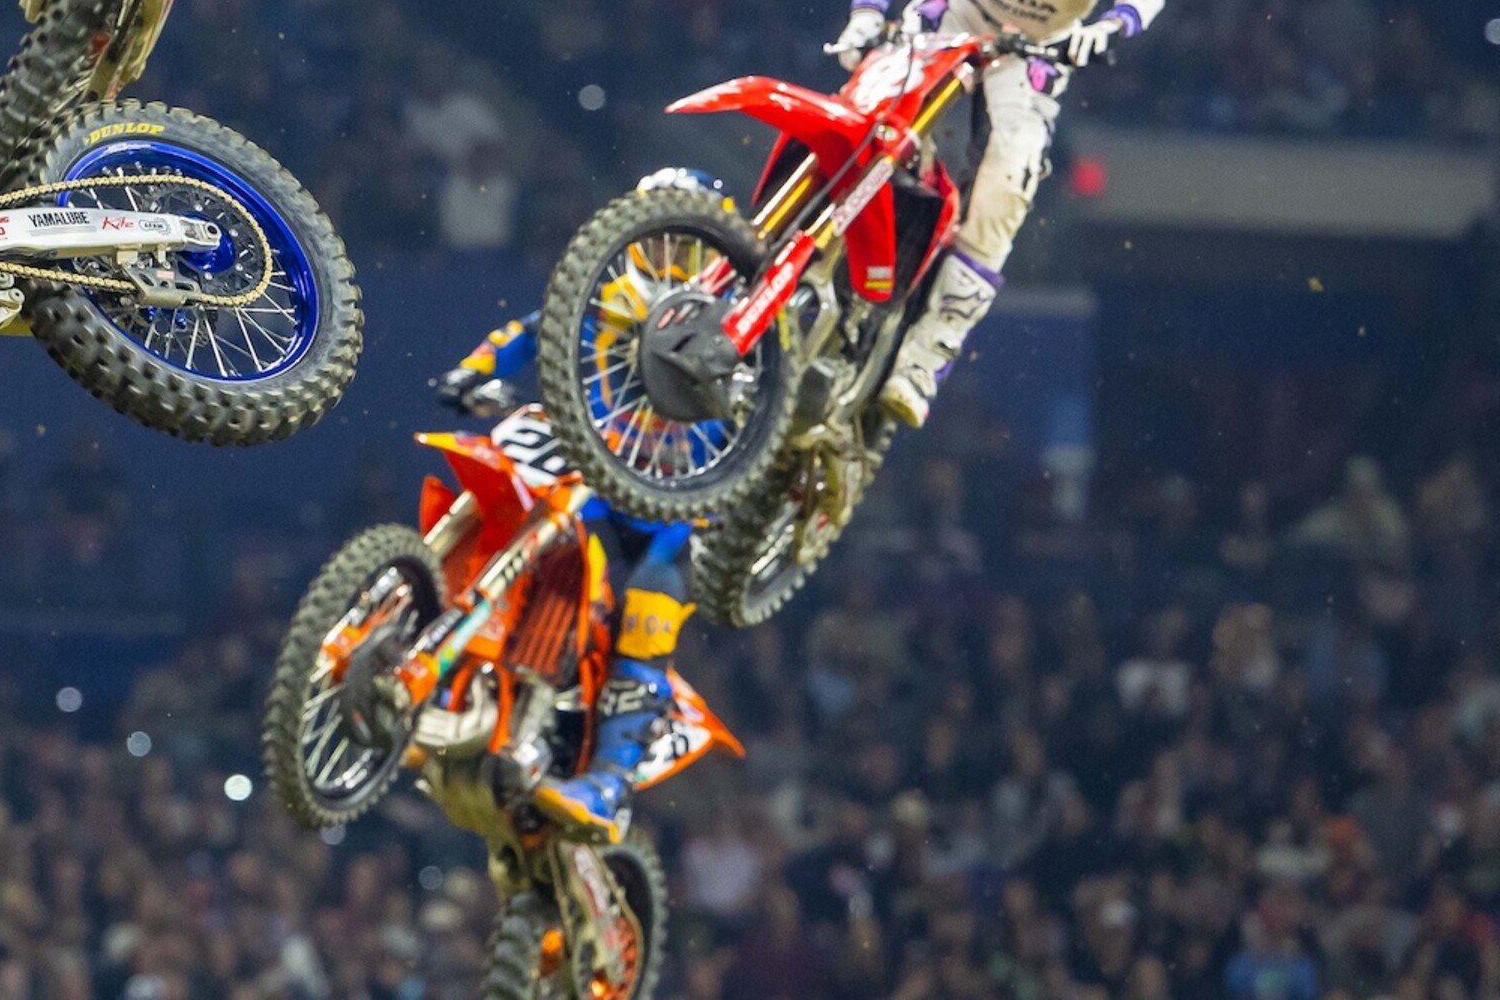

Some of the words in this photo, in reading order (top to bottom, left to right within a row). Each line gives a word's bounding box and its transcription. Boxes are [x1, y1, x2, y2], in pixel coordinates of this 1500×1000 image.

[88, 122, 166, 146] DUNLOP
[27, 210, 91, 228] YAMALUBE
[734, 261, 795, 337] DUNLOP
